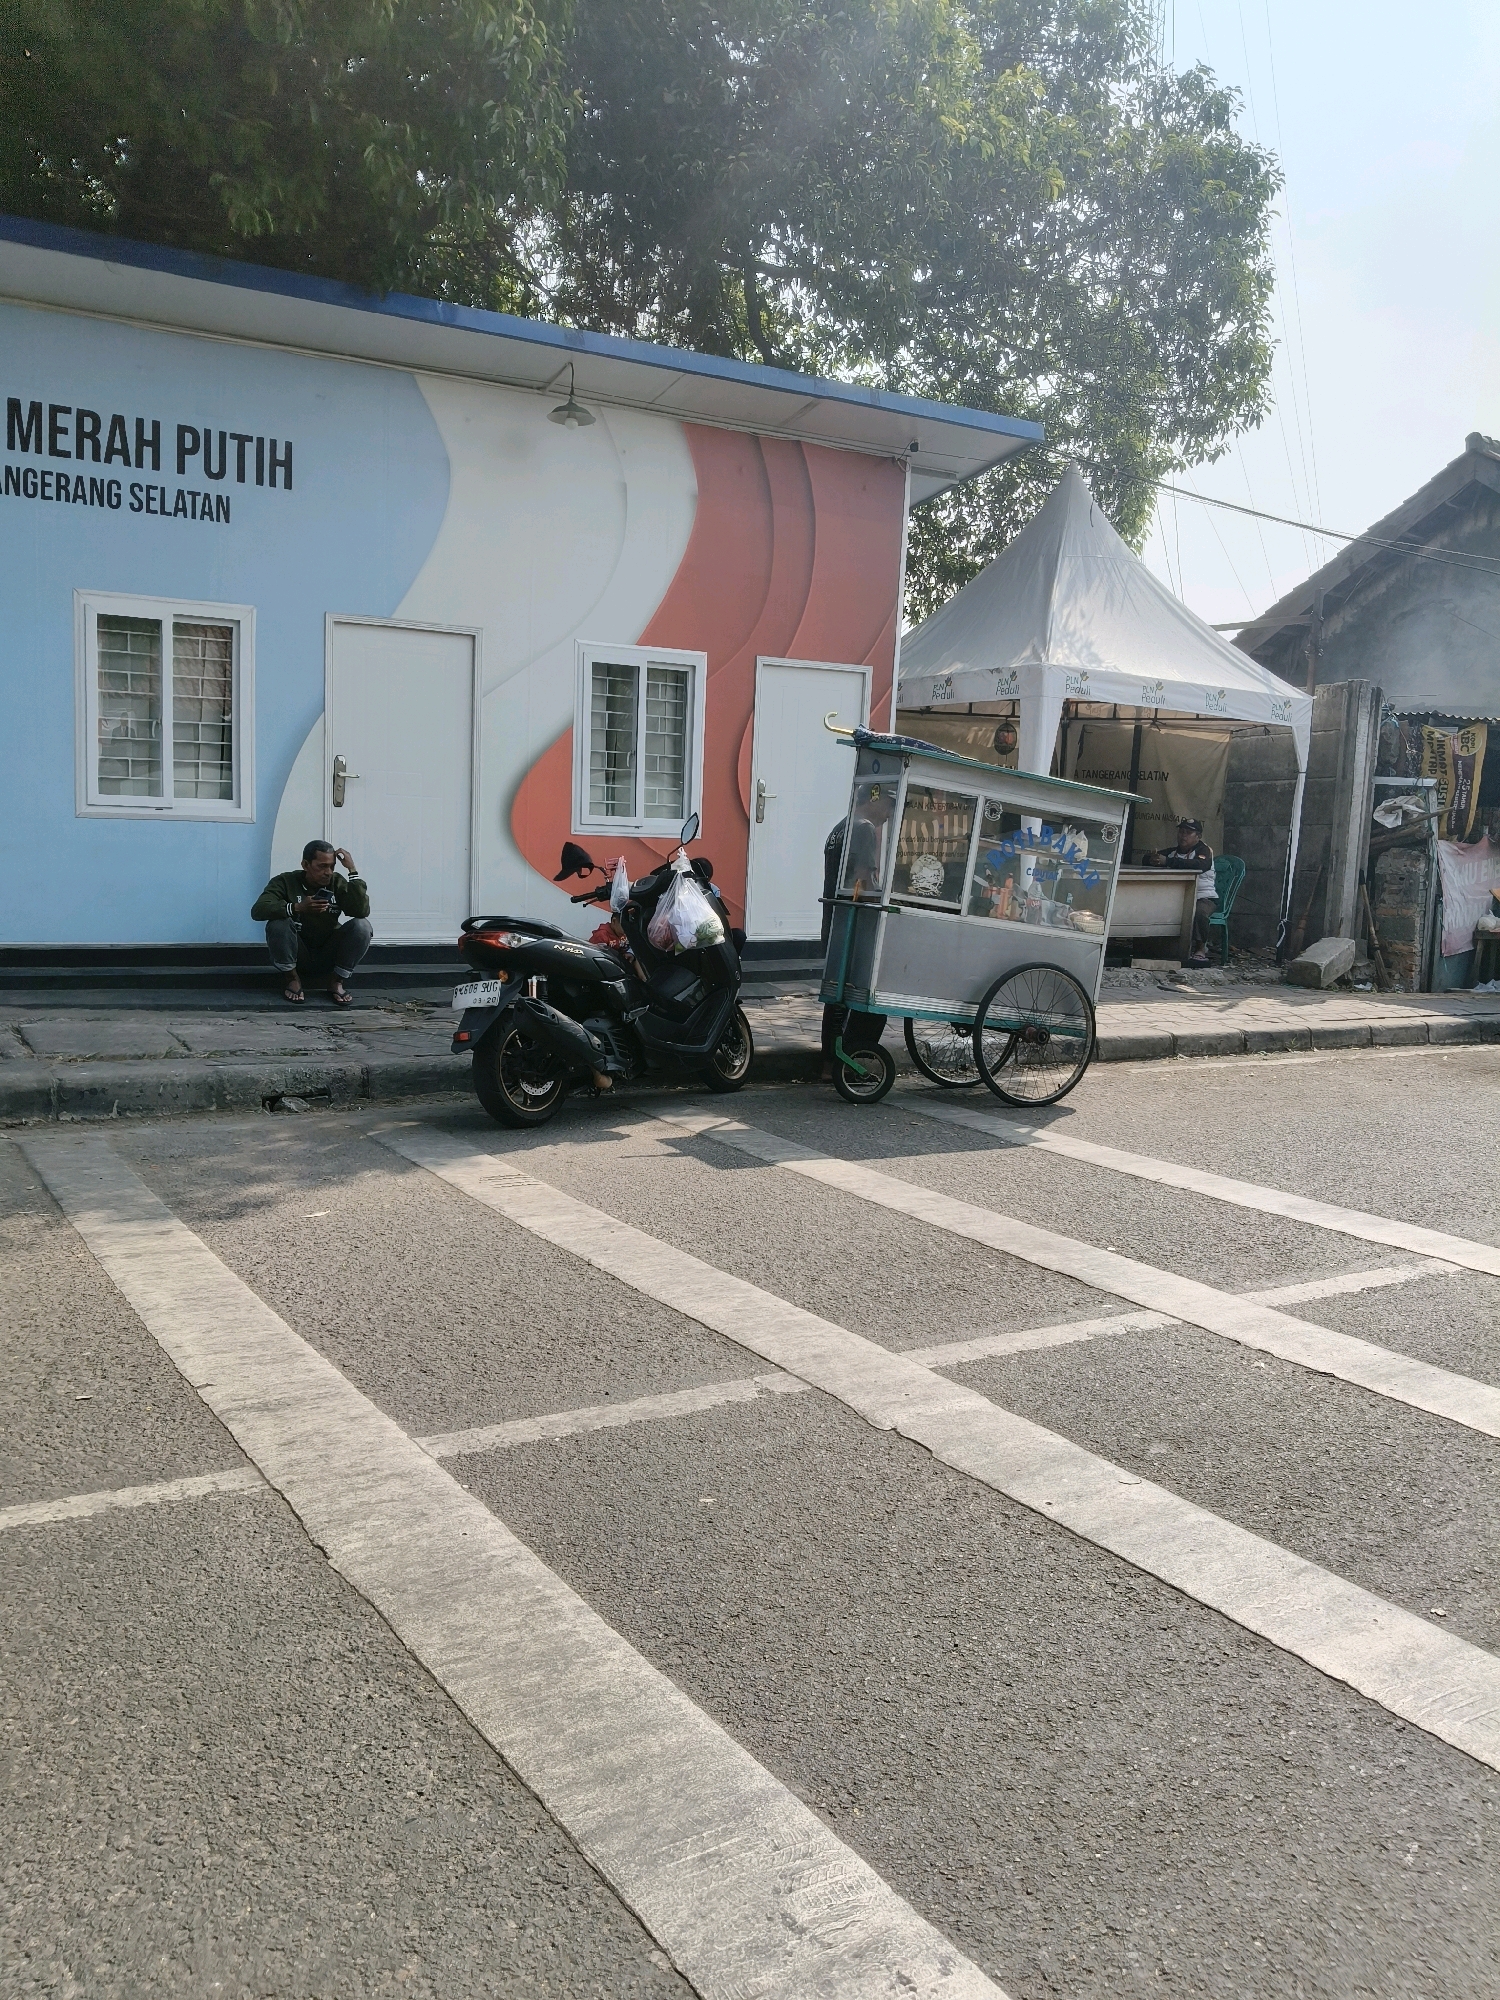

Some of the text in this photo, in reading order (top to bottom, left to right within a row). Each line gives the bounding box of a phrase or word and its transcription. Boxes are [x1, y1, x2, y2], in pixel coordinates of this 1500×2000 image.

[7, 397, 293, 490] MERAH PUTIH
[0, 465, 230, 524] NGERANG SELATAN
[997, 678, 1009, 687] PLN
[1065, 675, 1079, 684] PLN
[933, 683, 945, 692] PLN
[995, 685, 1020, 696] Peduli
[1065, 683, 1091, 696] Peduli
[1142, 686, 1155, 694] PLN
[932, 689, 955, 700] Peduli
[1141, 693, 1166, 705] Peduli
[1205, 692, 1218, 701] PLN
[1205, 701, 1227, 713] Peduli
[1271, 704, 1283, 712] PLN
[1271, 711, 1293, 722] Peduli
[1460, 730, 1470, 753] ABC
[1462, 778, 1471, 791] 25
[986, 824, 1101, 891] ROTI BAKAR
